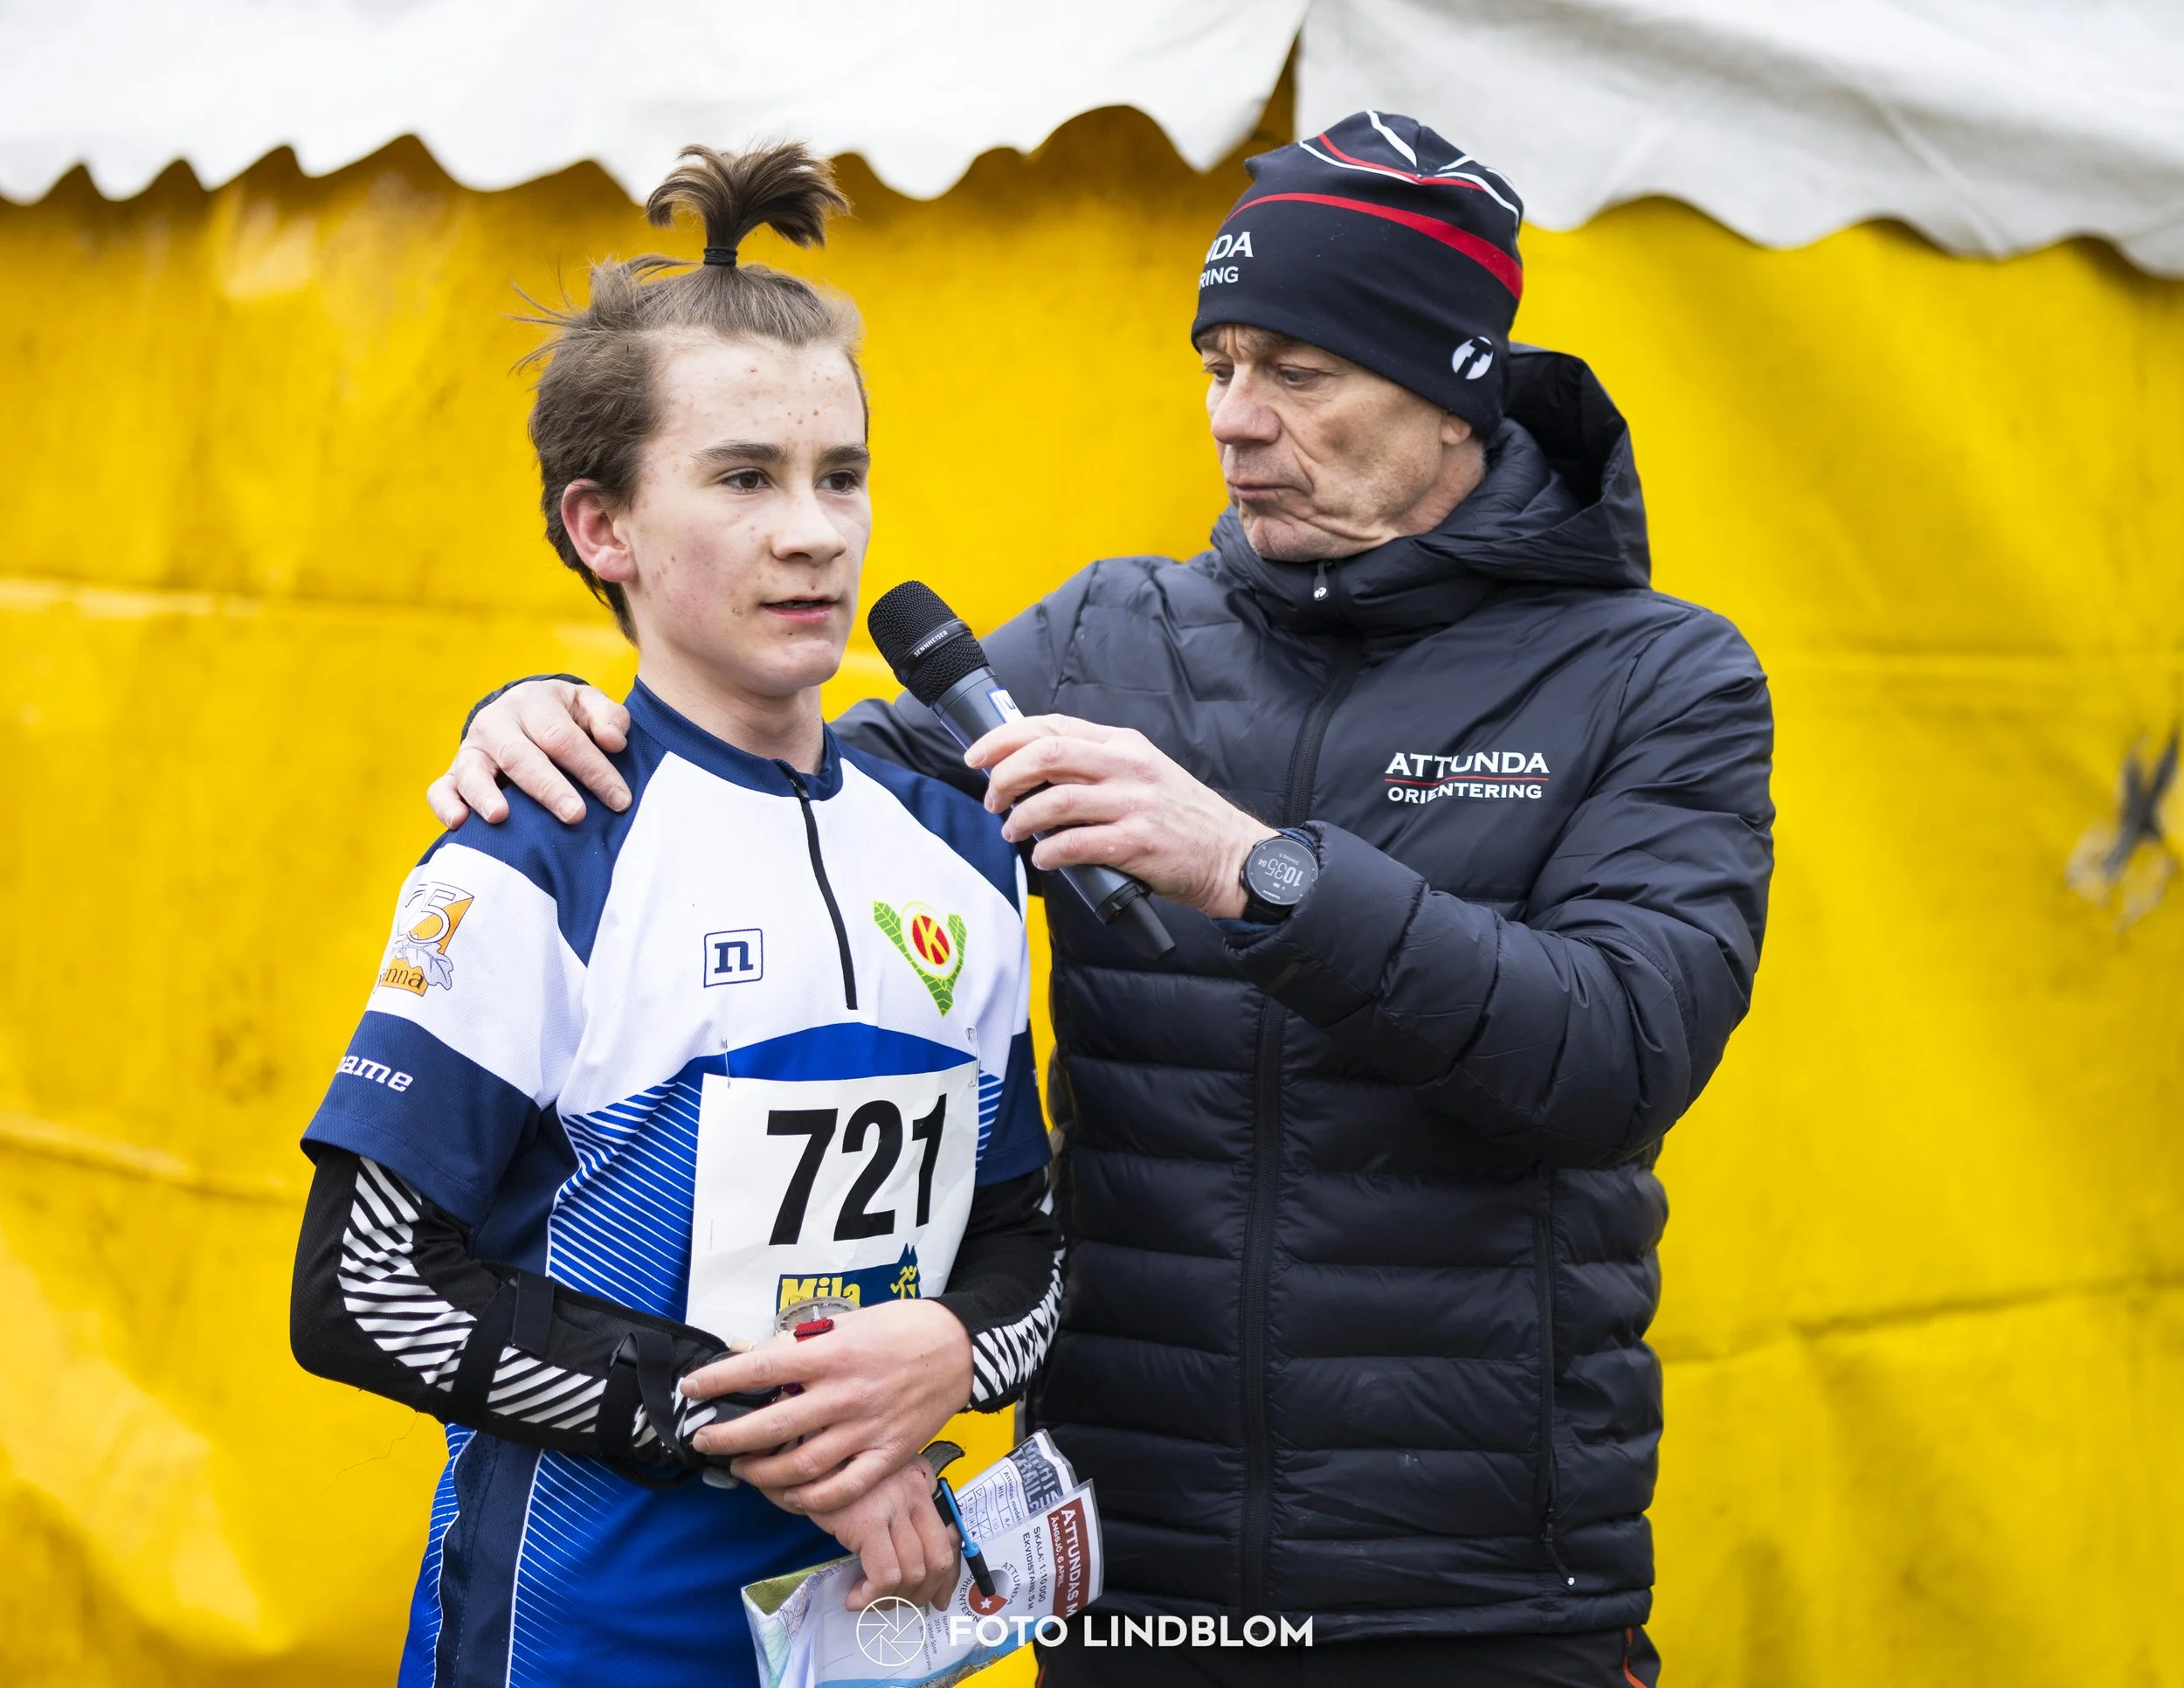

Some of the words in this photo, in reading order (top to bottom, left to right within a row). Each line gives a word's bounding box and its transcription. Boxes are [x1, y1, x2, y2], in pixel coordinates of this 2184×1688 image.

[914, 630, 949, 657] SENNHEISER
[1385, 751, 1550, 778] ATTUNDA
[1387, 782, 1543, 804] ORIENTERING
[1262, 889, 1281, 900] GARMIN
[714, 940, 754, 974] n
[766, 1092, 948, 1246] 721
[779, 1276, 861, 1312] Mila
[1010, 1448, 1042, 1502] TRAIL
[1033, 1526, 1045, 1562] SKALA:
[1061, 1509, 1082, 1602] ATTUNDAS
[1023, 1532, 1035, 1594] EKVIDISTANS:
[1002, 1562, 1020, 1605] ATTUNDA
